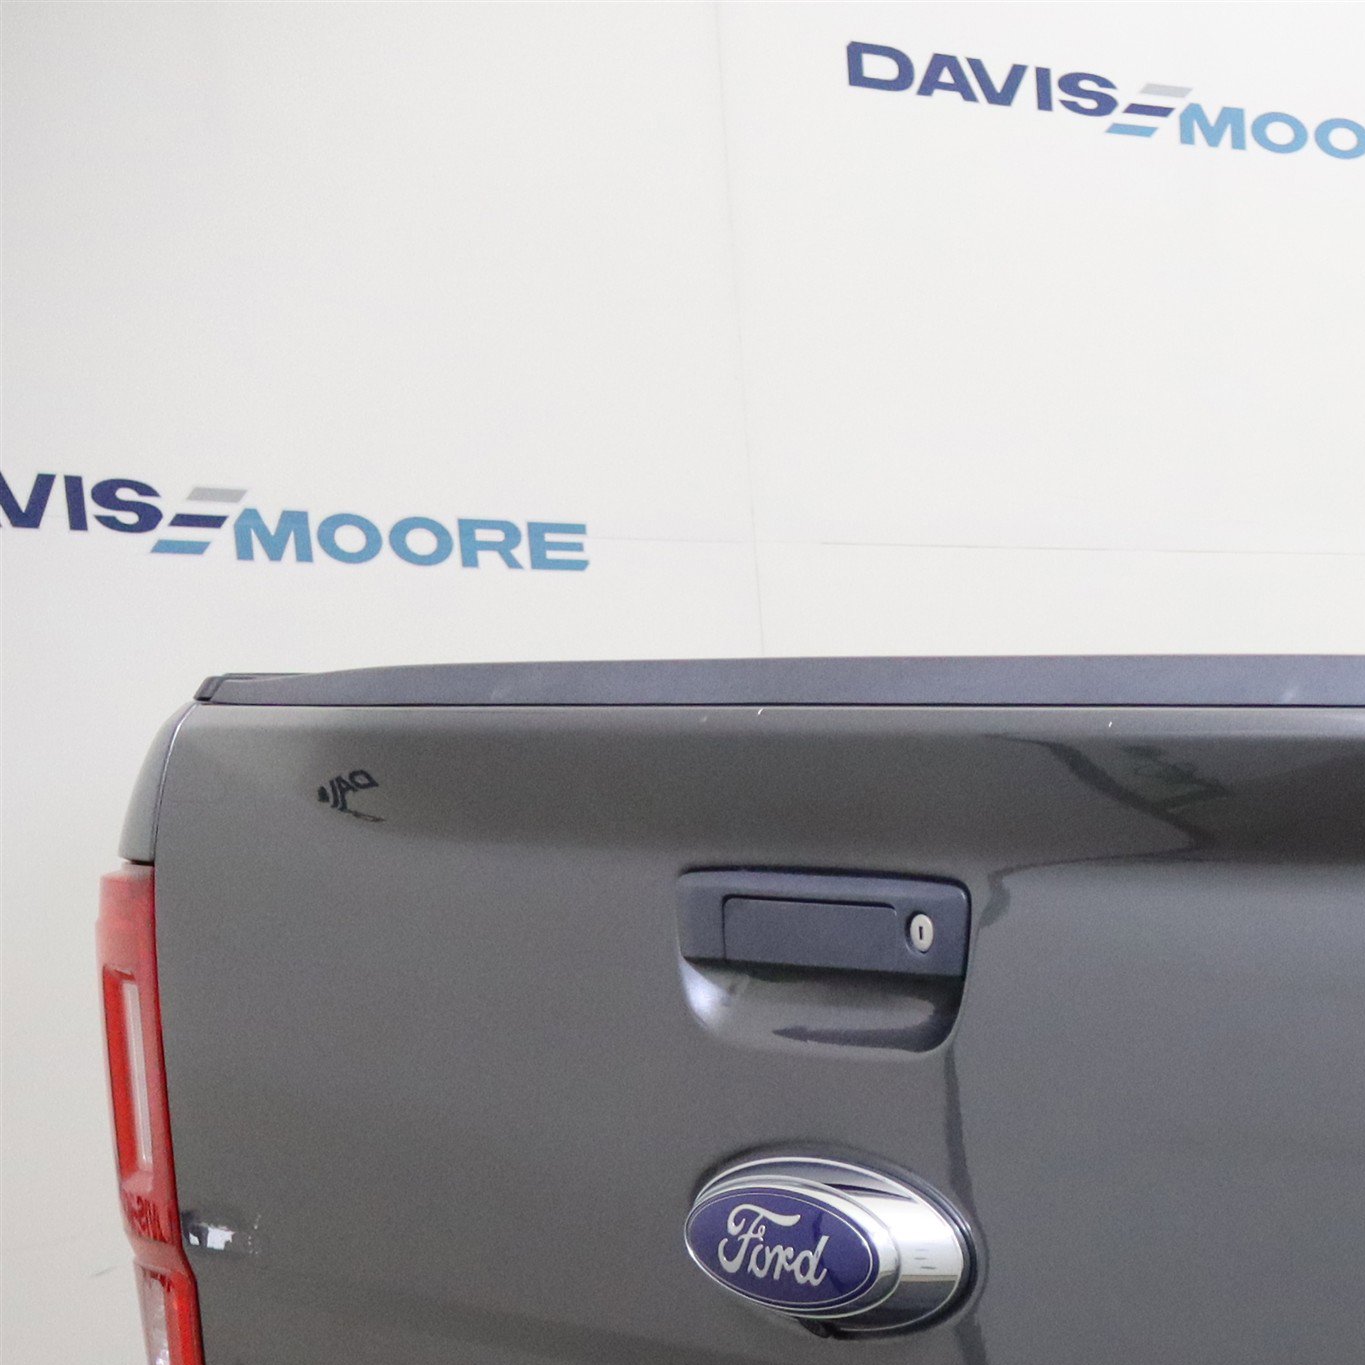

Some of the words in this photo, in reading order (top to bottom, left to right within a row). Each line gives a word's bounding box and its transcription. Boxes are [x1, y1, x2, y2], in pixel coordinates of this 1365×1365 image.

[846, 40, 1119, 118] DAVIS
[0, 472, 164, 534] VIS
[233, 508, 591, 571] MOORE
[717, 1203, 830, 1287] Ford
